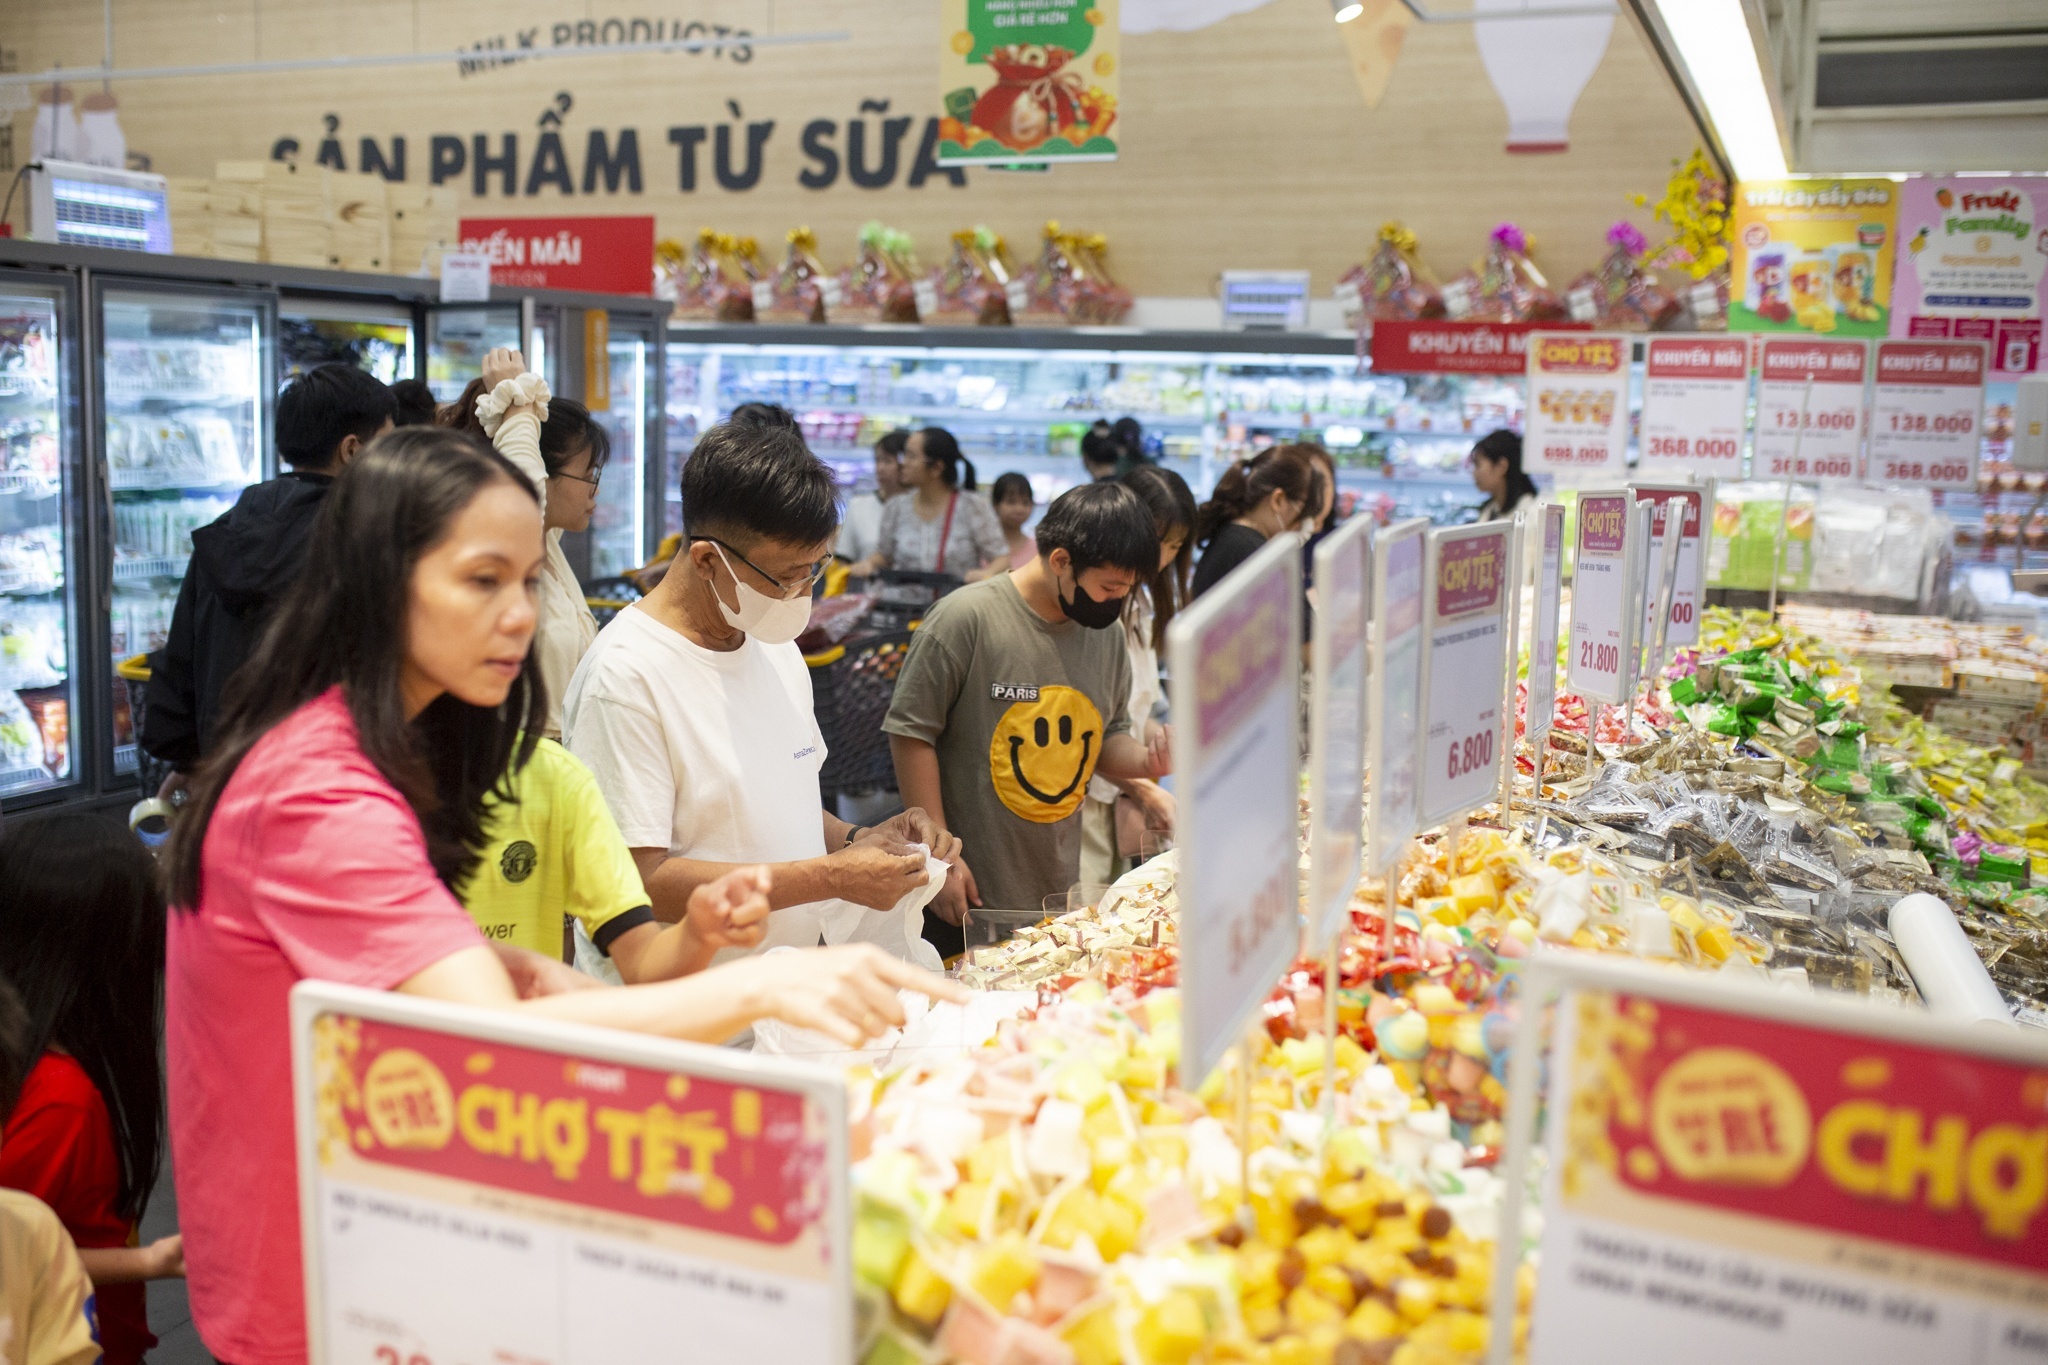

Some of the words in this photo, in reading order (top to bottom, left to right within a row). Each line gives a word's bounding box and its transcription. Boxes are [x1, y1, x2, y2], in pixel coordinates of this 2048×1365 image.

[552, 18, 755, 64] PRODUCTS
[430, 91, 643, 196] PHẨM
[668, 98, 775, 193] TỪ
[797, 99, 968, 190] SỮA
[1961, 189, 2020, 213] Fruit
[1945, 214, 2032, 241] Family
[530, 230, 582, 266] MÃI
[1408, 326, 1504, 354] KHUYẾN
[1653, 345, 1711, 366] KHUYẾN
[1713, 346, 1743, 367] MÃI
[1767, 347, 1827, 370] KHUYẾN
[1831, 348, 1861, 370] MÃI
[1881, 350, 1944, 372] KHUYẾN
[1948, 352, 1979, 373] MÃI
[1889, 414, 1973, 434] 138.000
[1648, 436, 1737, 459] 368.000
[1884, 461, 1969, 483] 368.000
[1587, 510, 1605, 537] CHỢ
[1605, 507, 1622, 539] TẾT
[1443, 556, 1471, 593] CHỢ
[1472, 548, 1496, 591] TẾT
[1580, 640, 1618, 674] 21.800
[994, 686, 1037, 699] PARIS
[1448, 729, 1493, 779] 6.800
[458, 1084, 590, 1181] CHỢ
[595, 1103, 731, 1205] TẾT
[1816, 1100, 2048, 1240] CHỢ
